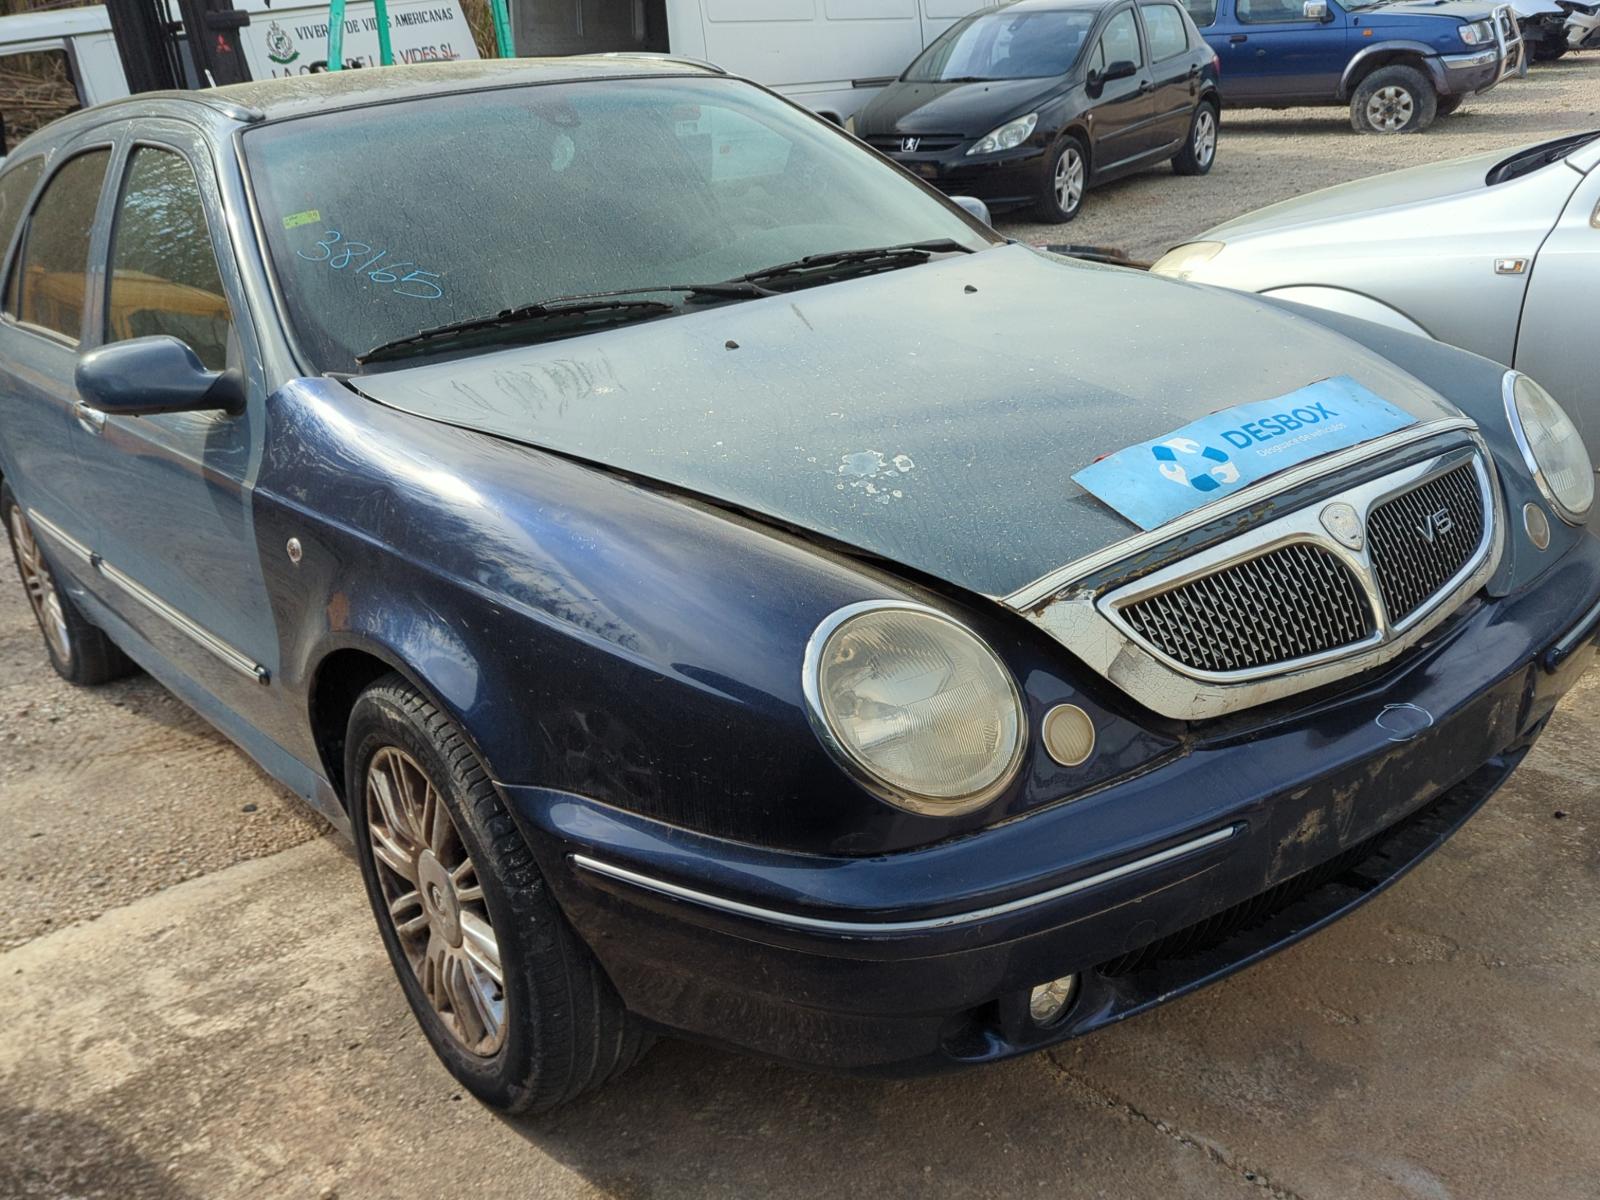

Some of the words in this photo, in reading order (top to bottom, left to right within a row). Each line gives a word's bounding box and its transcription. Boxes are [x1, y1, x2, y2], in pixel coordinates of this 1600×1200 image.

[295, 24, 330, 40] VIVER
[344, 19, 360, 34] DE
[394, 7, 454, 28] AMERICANAS
[399, 45, 438, 65] VIDES
[1220, 401, 1340, 450] DESBOX
